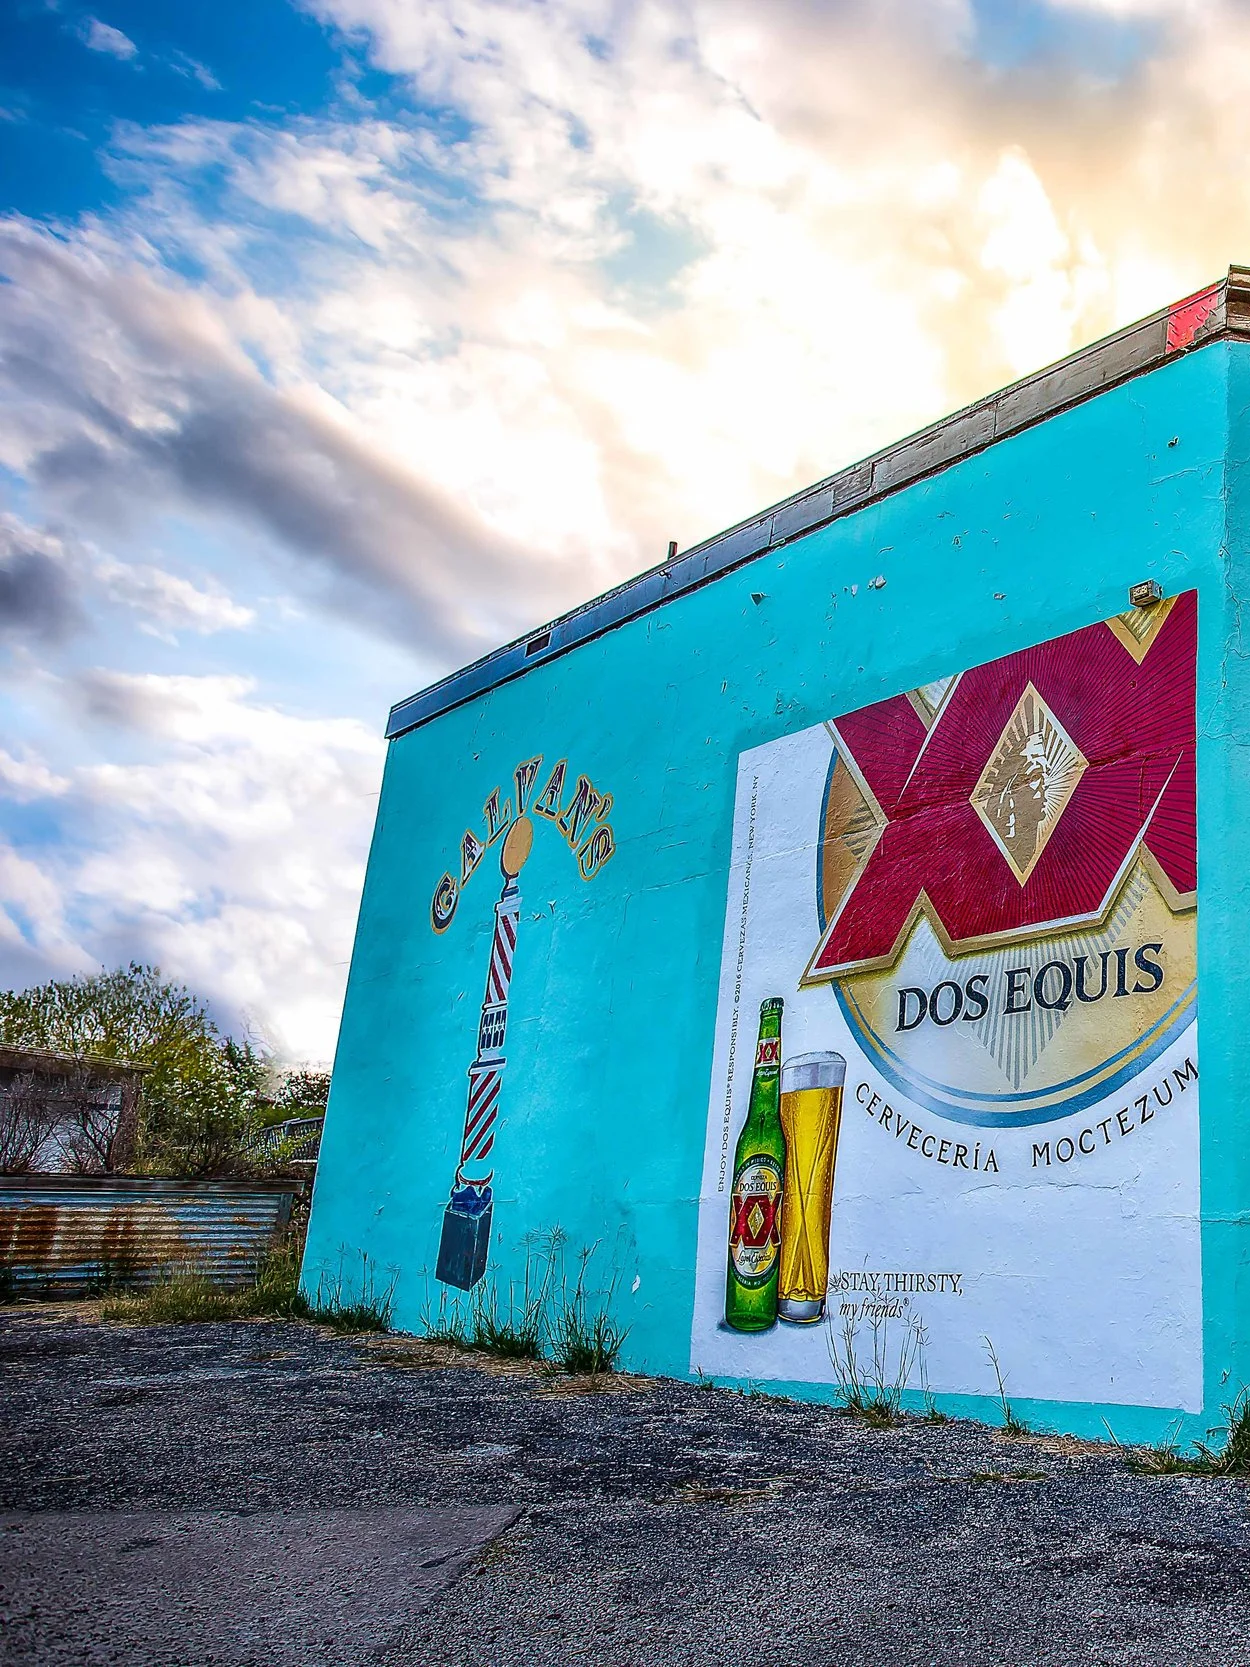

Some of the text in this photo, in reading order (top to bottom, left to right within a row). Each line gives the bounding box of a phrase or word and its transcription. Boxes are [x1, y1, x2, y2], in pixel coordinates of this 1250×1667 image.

[752, 775, 759, 789] NY
[430, 754, 616, 934] GALVAN'S
[736, 917, 747, 972] CERVEZAS
[894, 941, 1164, 1033] DOS EQUIS
[727, 1006, 740, 1081] RESPONSIBLY.
[722, 1126, 730, 1150] DOS
[855, 1082, 999, 1173] CERVECERÍA
[718, 1154, 727, 1192] ENJOY
[740, 1181, 777, 1192] DOS EQUIS
[883, 1273, 963, 1296] THIRSTY,
[840, 1303, 858, 1321] my
